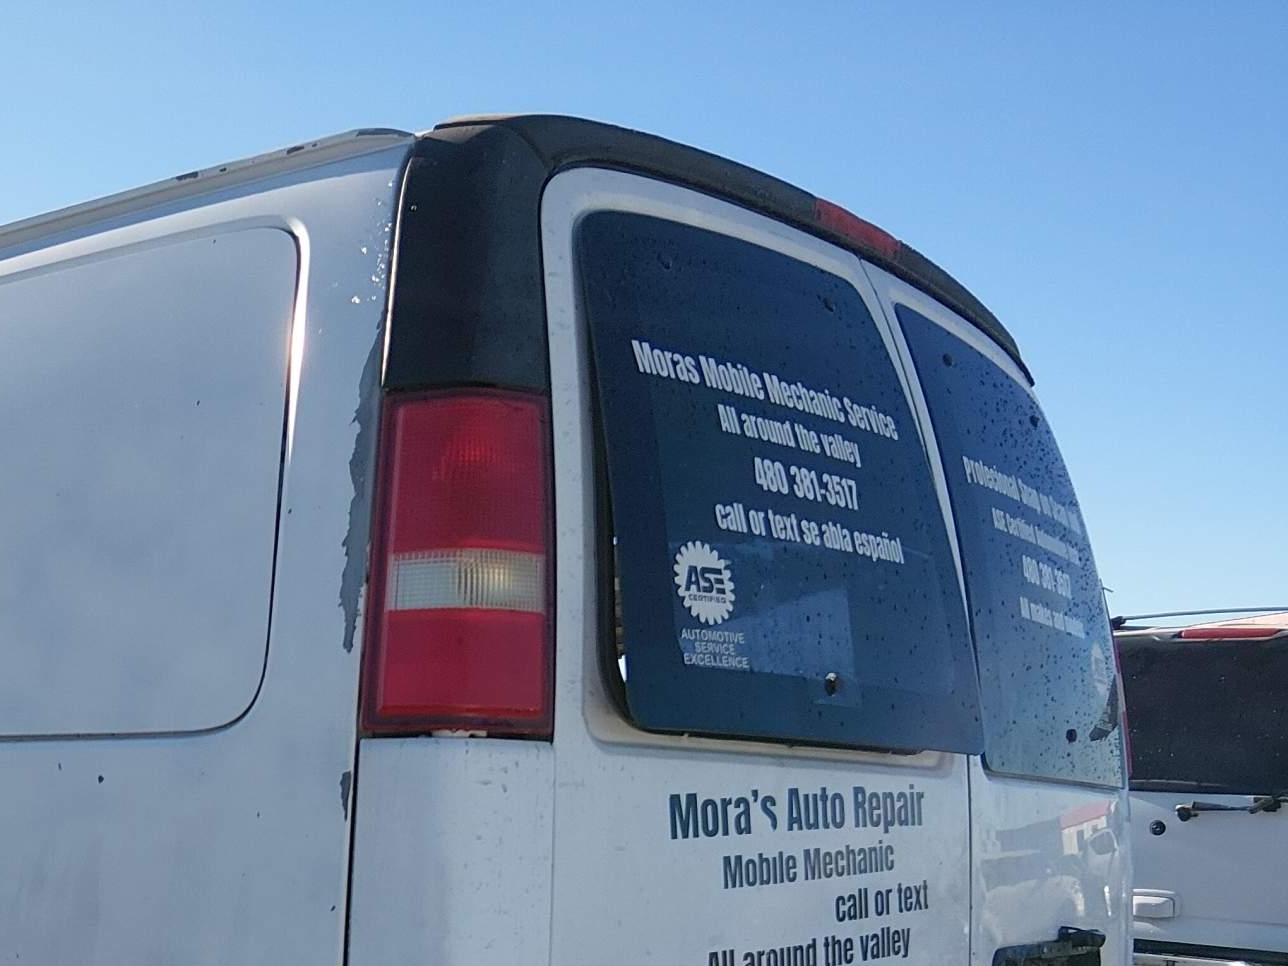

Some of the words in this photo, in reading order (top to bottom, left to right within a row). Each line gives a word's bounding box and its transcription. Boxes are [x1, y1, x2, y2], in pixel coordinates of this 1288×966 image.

[631, 339, 700, 385] Moras
[698, 354, 765, 400] Mobile
[762, 371, 846, 423] Mechanic
[842, 396, 899, 441] Service
[717, 403, 741, 435] All
[740, 412, 796, 448] around
[794, 422, 821, 454] the
[819, 432, 862, 468] valley
[754, 456, 789, 495] 480
[789, 465, 859, 511] 381-3517
[714, 502, 748, 534] call
[748, 508, 767, 537] or
[767, 508, 801, 543] text
[800, 518, 822, 547] se
[821, 521, 854, 553] abla
[852, 531, 905, 565] español
[684, 565, 727, 595] ASE
[681, 628, 745, 644] AUTOMOTIVE
[694, 641, 736, 656] SERVICE
[683, 653, 750, 669] EXCELLENCE
[668, 789, 778, 840] Mora's
[786, 786, 846, 832] Auto
[852, 784, 925, 834] Repair
[722, 851, 797, 889] Mobile
[803, 839, 895, 882] Mechanic
[835, 887, 869, 923] call
[874, 889, 891, 917] or
[897, 879, 929, 914] text
[859, 926, 911, 959] valley
